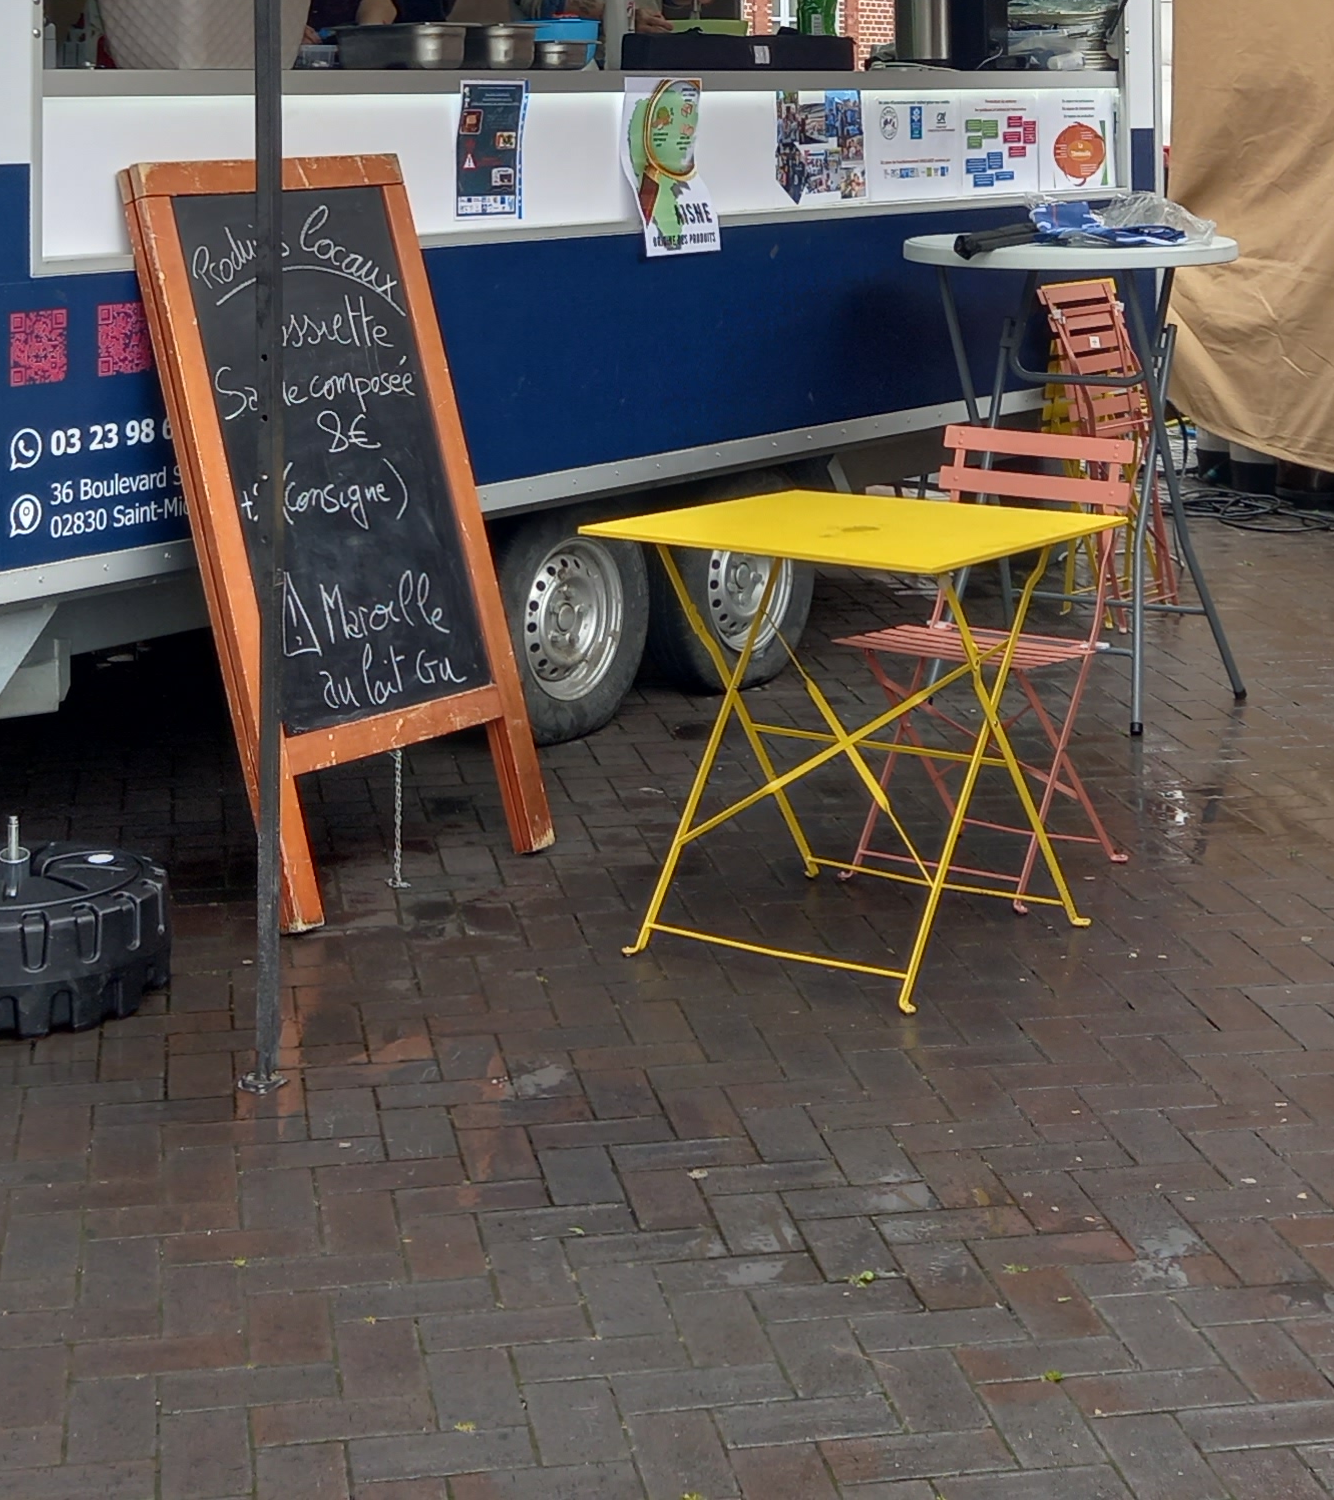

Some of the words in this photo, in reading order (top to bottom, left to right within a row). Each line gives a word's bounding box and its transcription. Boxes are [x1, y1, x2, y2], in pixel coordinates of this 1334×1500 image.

[674, 202, 713, 226] AISNE
[191, 223, 290, 289] Produis
[689, 231, 716, 244] PRODUITS
[282, 294, 395, 348] ssiette
[309, 355, 416, 413] composée
[50, 427, 81, 456] 03
[89, 422, 119, 451] 23
[125, 418, 155, 446] 98
[162, 417, 174, 440] 6
[316, 409, 381, 453] 8€
[50, 481, 74, 506] 36
[80, 466, 167, 501] Boulevard
[173, 465, 182, 485] S
[50, 508, 107, 539] 02830
[113, 495, 190, 528] Saint-Mic
[319, 671, 360, 709] au
[362, 643, 406, 706] lait
